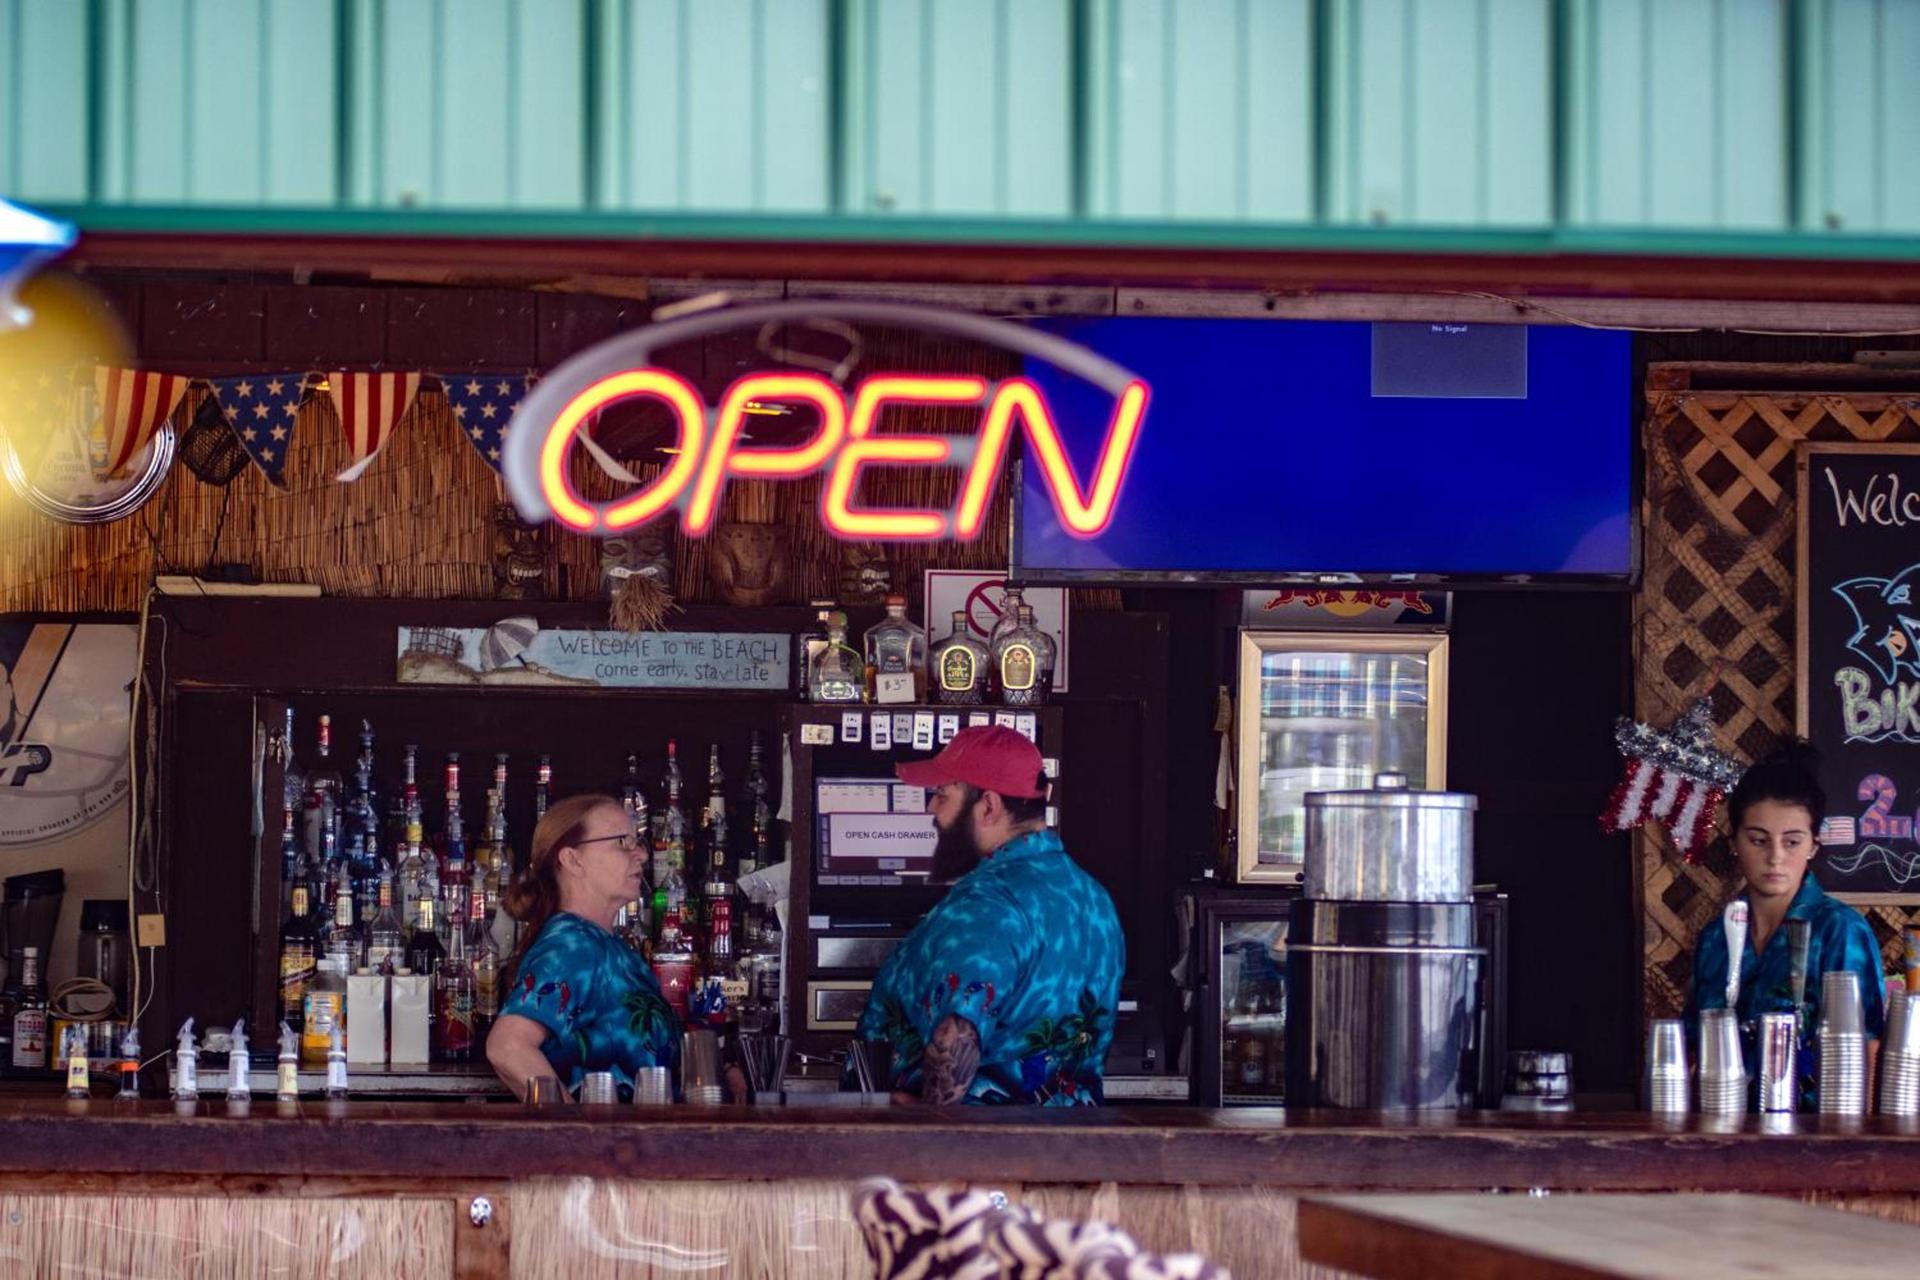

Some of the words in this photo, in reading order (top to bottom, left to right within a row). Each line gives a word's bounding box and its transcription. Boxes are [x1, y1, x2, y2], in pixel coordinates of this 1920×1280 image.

[1431, 324, 1443, 333] No
[1444, 324, 1468, 334] Signal
[538, 366, 1152, 542] OPEN
[558, 635, 652, 658] WELCOME
[661, 639, 679, 656] TO
[682, 638, 705, 656] THE
[594, 662, 640, 679] come
[735, 661, 770, 681] late
[845, 831, 871, 840] OPEN
[871, 831, 896, 840] CASH
[896, 831, 937, 840] DRAWER
